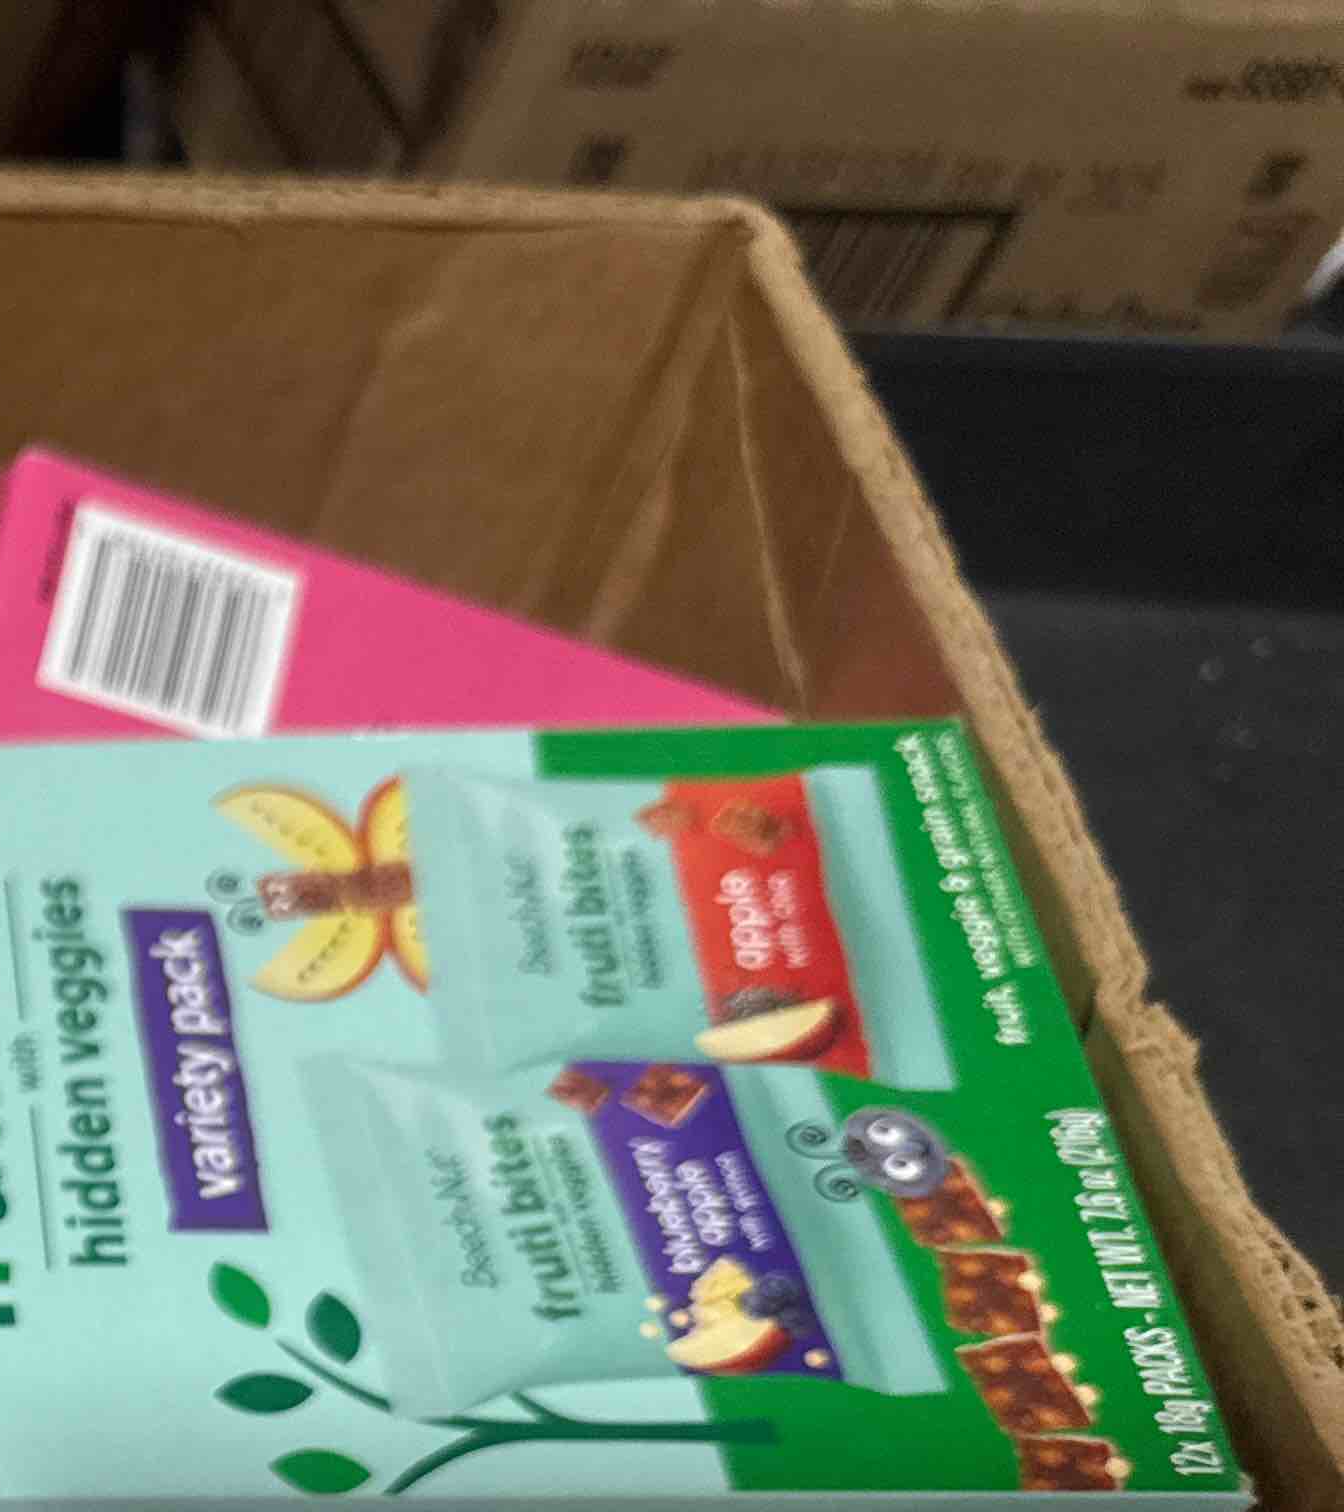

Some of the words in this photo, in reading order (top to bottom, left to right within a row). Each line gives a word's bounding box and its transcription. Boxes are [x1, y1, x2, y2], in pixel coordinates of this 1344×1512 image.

[920, 805, 970, 870] grain
[717, 868, 772, 971] apple
[950, 895, 1005, 980] veggie
[31, 873, 109, 1064] veggies
[149, 925, 228, 1037] pack
[15, 1032, 43, 1091] with
[174, 1037, 244, 1200] variety
[64, 1076, 128, 1267] hidden
[484, 1114, 546, 1216] bites
[675, 1161, 732, 1247] apple
[1074, 1193, 1130, 1222] 7.6
[508, 1222, 582, 1320] fruti
[1101, 1271, 1161, 1308] NET
[1123, 1326, 1194, 1395] PACKS
[1154, 1399, 1213, 1434] 18g
[1170, 1440, 1224, 1475] 12x
